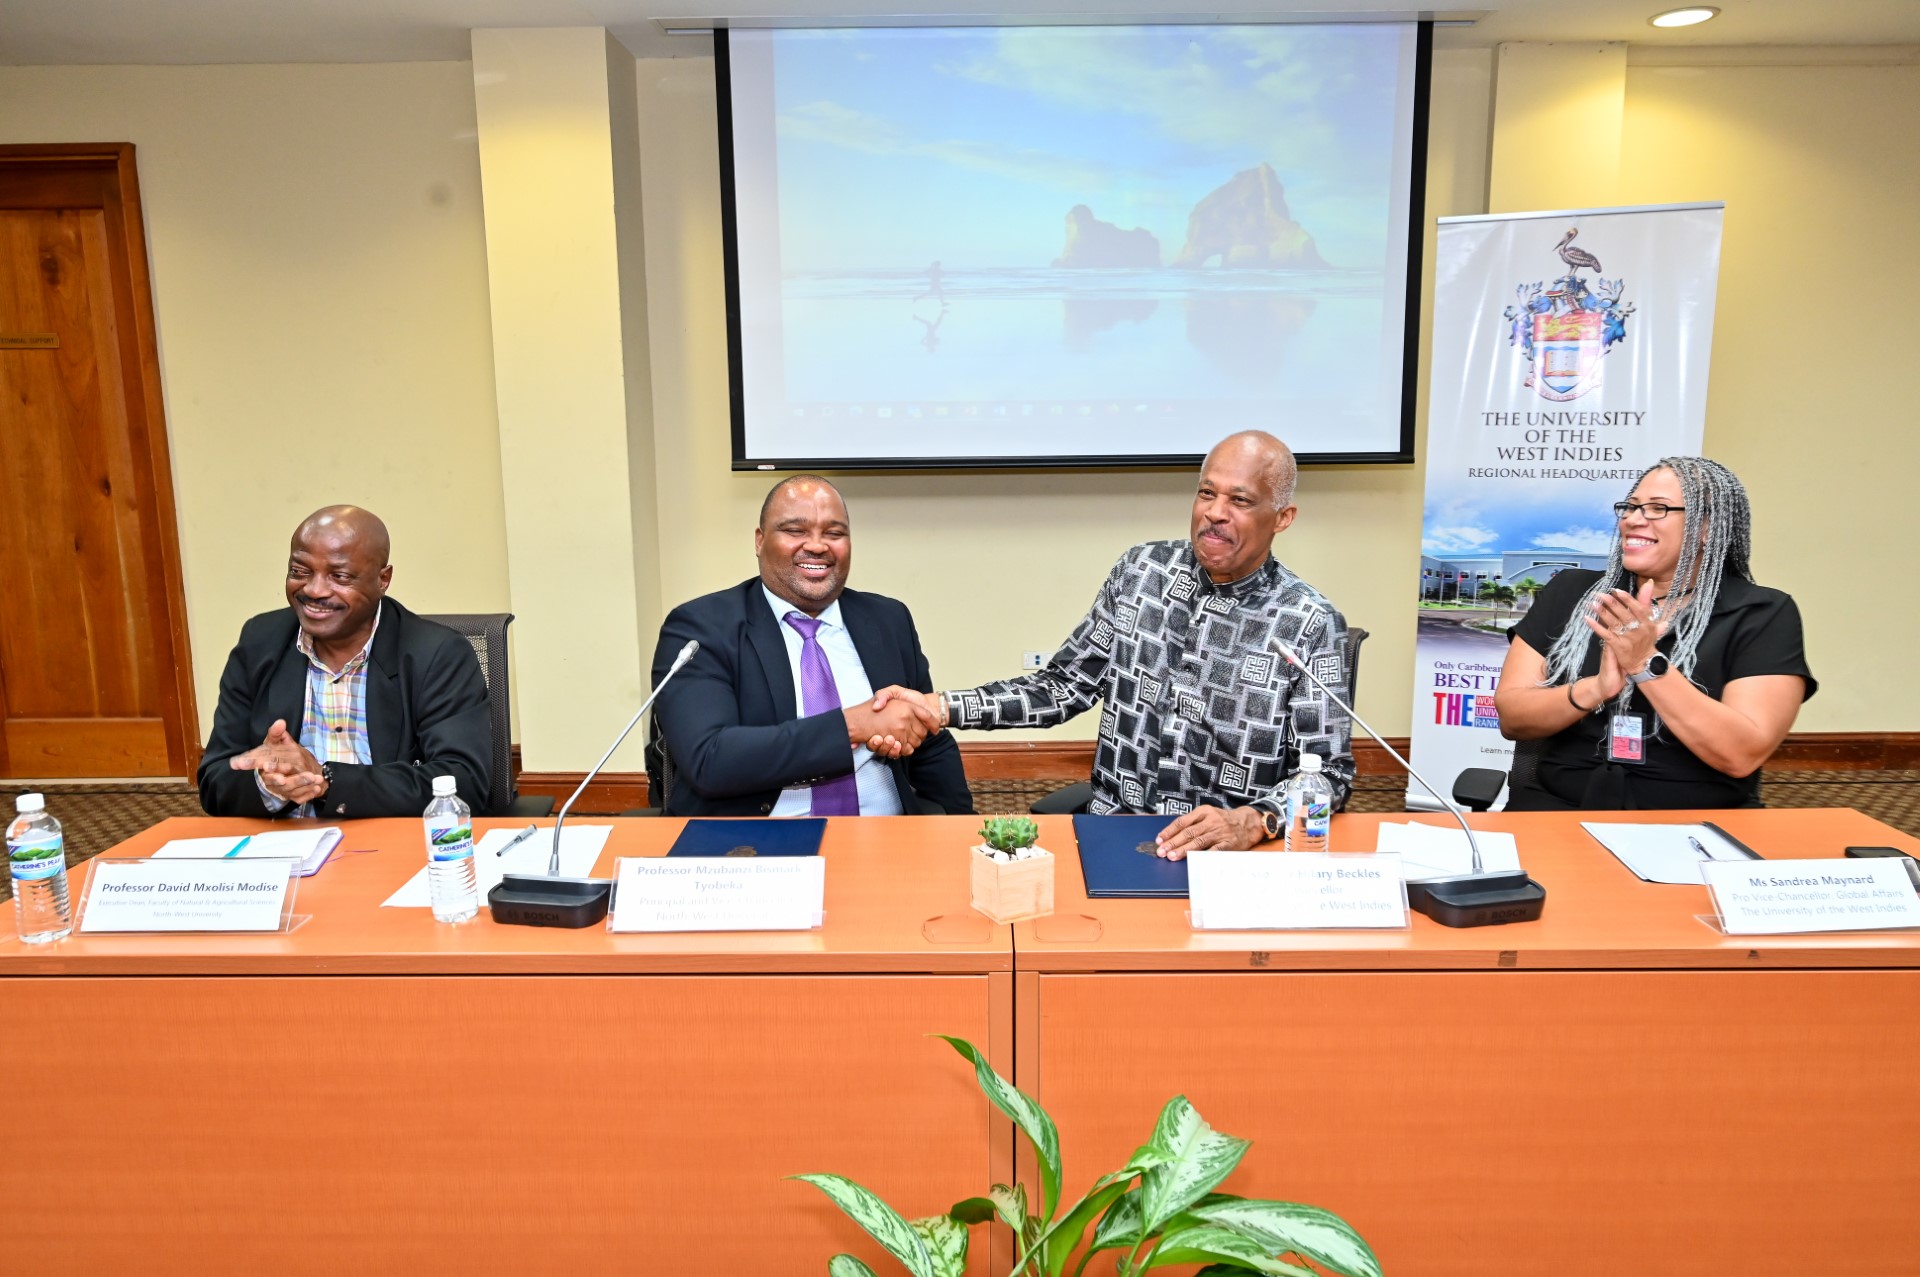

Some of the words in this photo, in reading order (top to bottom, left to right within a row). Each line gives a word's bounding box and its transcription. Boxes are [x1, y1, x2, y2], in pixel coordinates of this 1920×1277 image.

[1481, 412, 1521, 426] THE
[1526, 411, 1646, 426] UNIVERSITY
[1525, 429, 1551, 443] OF
[1555, 429, 1596, 443] THE
[1497, 447, 1549, 461] WEST
[1553, 447, 1623, 462] INDIES
[1468, 468, 1537, 479] REGIONAL
[1541, 468, 1644, 482] HEADQUARTER
[1434, 661, 1455, 671] Only
[1434, 672, 1484, 689] BEST
[1477, 696, 1495, 705] WOR
[1433, 692, 1475, 727] THE
[1476, 707, 1499, 717] UNIV
[1476, 719, 1499, 728] RANK
[1480, 746, 1502, 755] Learn
[637, 866, 692, 875] Professor
[696, 865, 751, 874] Mzubanzi
[1336, 869, 1381, 879] Beckles
[1749, 878, 1767, 887] Ms
[1770, 876, 1819, 887] Sandrea
[1821, 875, 1875, 887] Maynard
[102, 883, 153, 893] Professor
[157, 882, 190, 892] David
[194, 882, 234, 893] Mxolisi
[237, 882, 278, 892] Modise
[694, 881, 743, 892] Tyobeka
[1732, 893, 1750, 902] Pro
[1837, 890, 1869, 900] Global
[1872, 889, 1904, 899] Affairs
[180, 899, 203, 907] Natural
[1329, 901, 1356, 910] West
[1360, 900, 1392, 910] Indies
[1491, 909, 1527, 919] BOSCH
[1741, 907, 1760, 916] The
[1762, 905, 1813, 917] University
[1816, 904, 1827, 914] of
[1829, 904, 1845, 914] the
[1848, 904, 1875, 913] West
[1876, 903, 1907, 912] Indies
[524, 912, 559, 920] BOSCH
